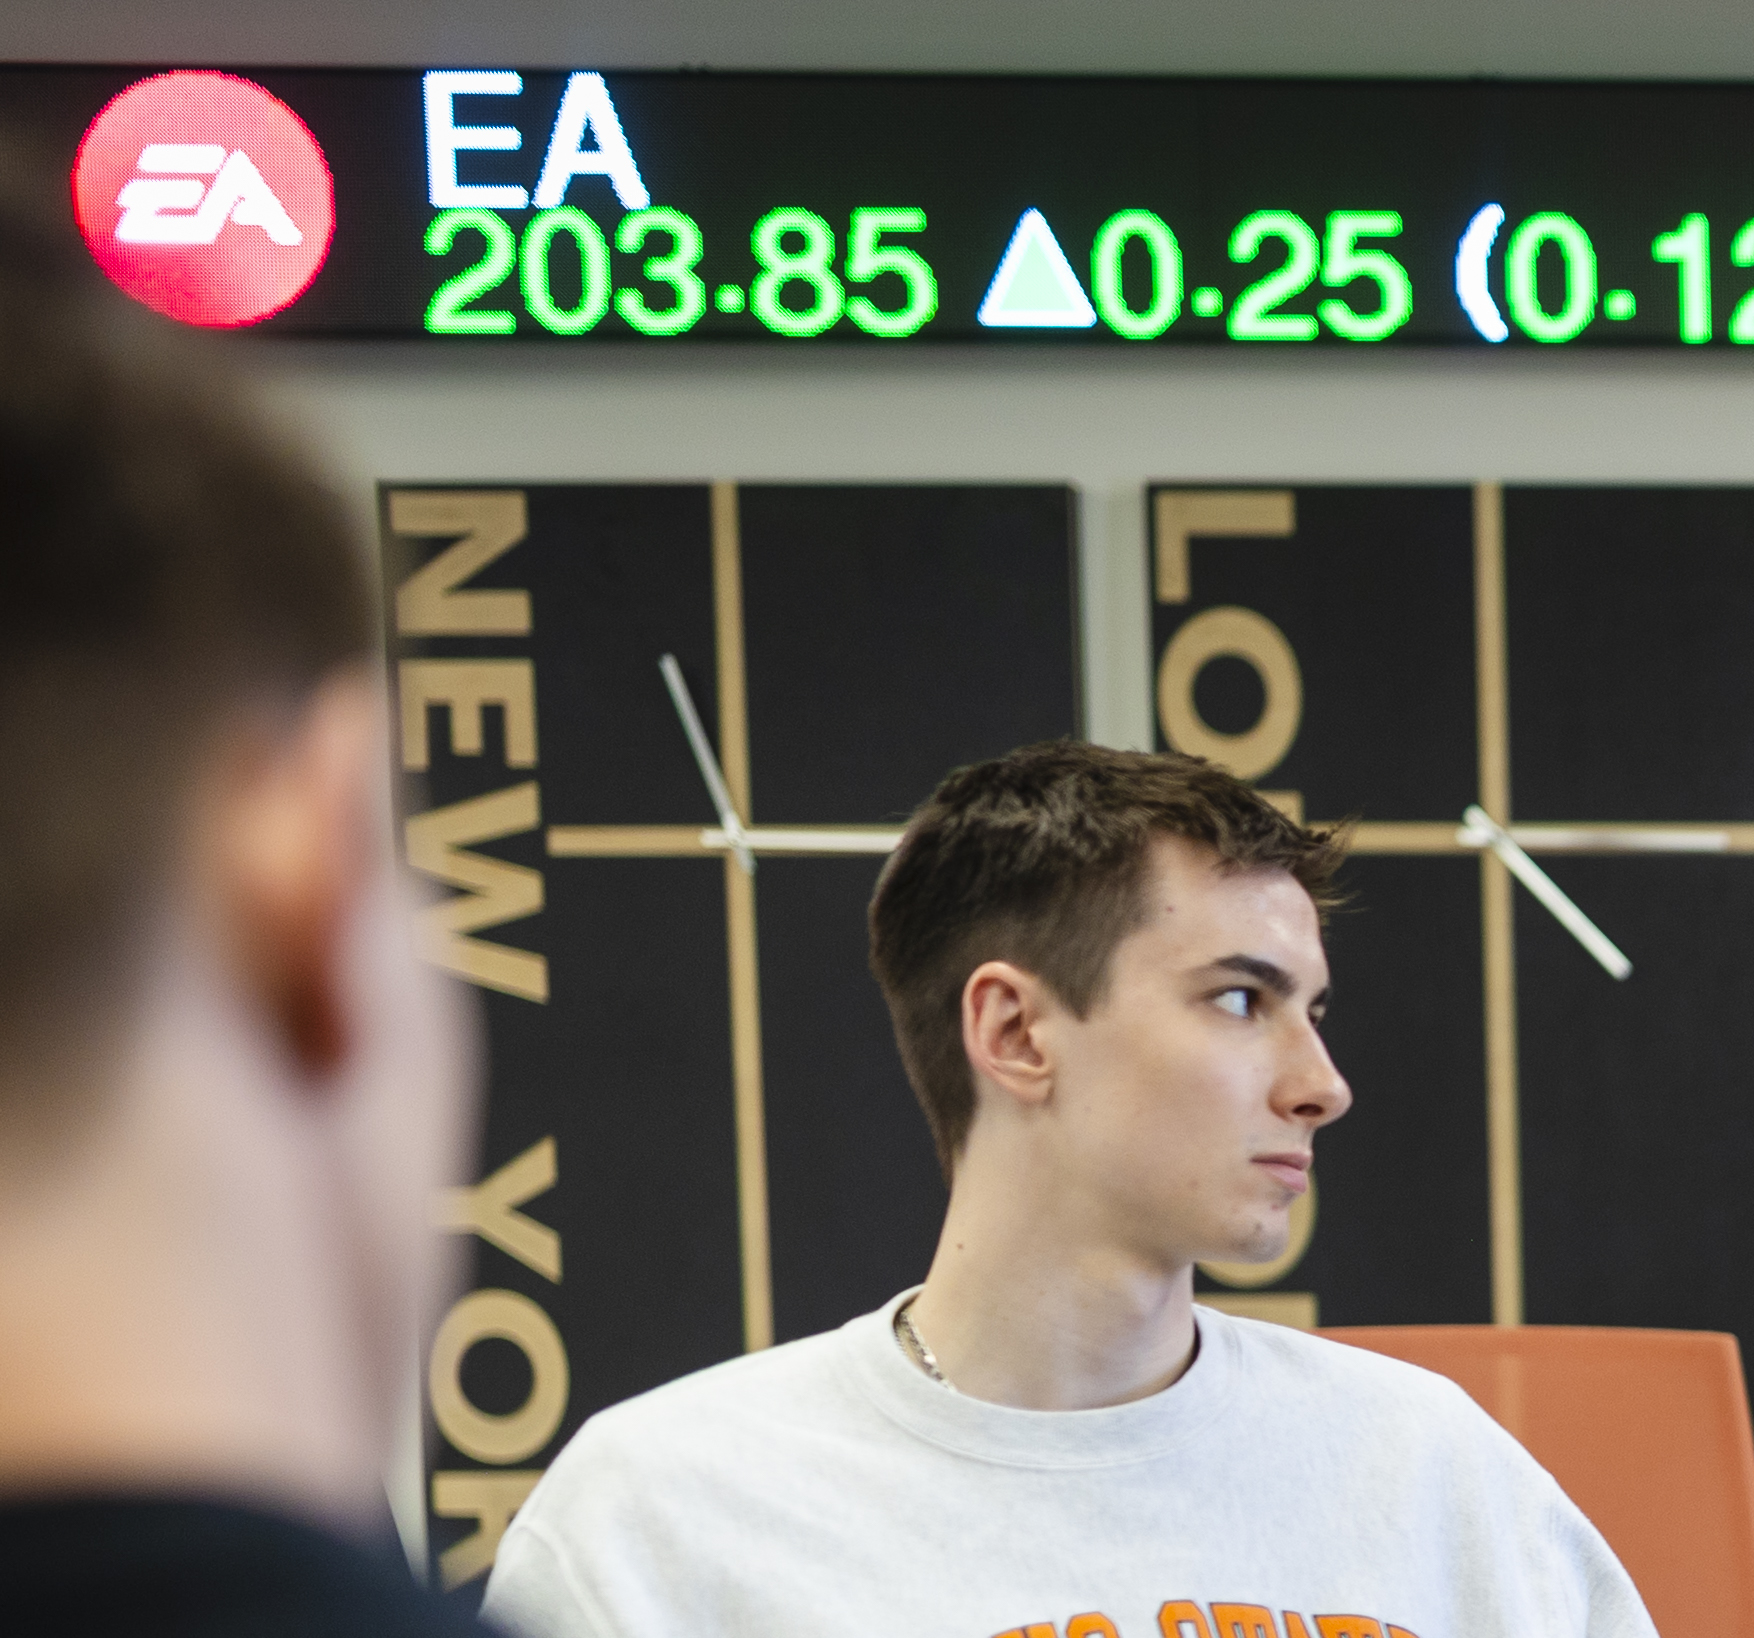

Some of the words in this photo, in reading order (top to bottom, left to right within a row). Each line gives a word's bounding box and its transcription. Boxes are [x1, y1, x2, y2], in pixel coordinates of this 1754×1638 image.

[421, 71, 650, 210] EA
[423, 206, 939, 336] 203.85
[1090, 208, 1414, 341] 0.25
[388, 490, 549, 1003] NEW
[428, 1136, 569, 1594] YOR
